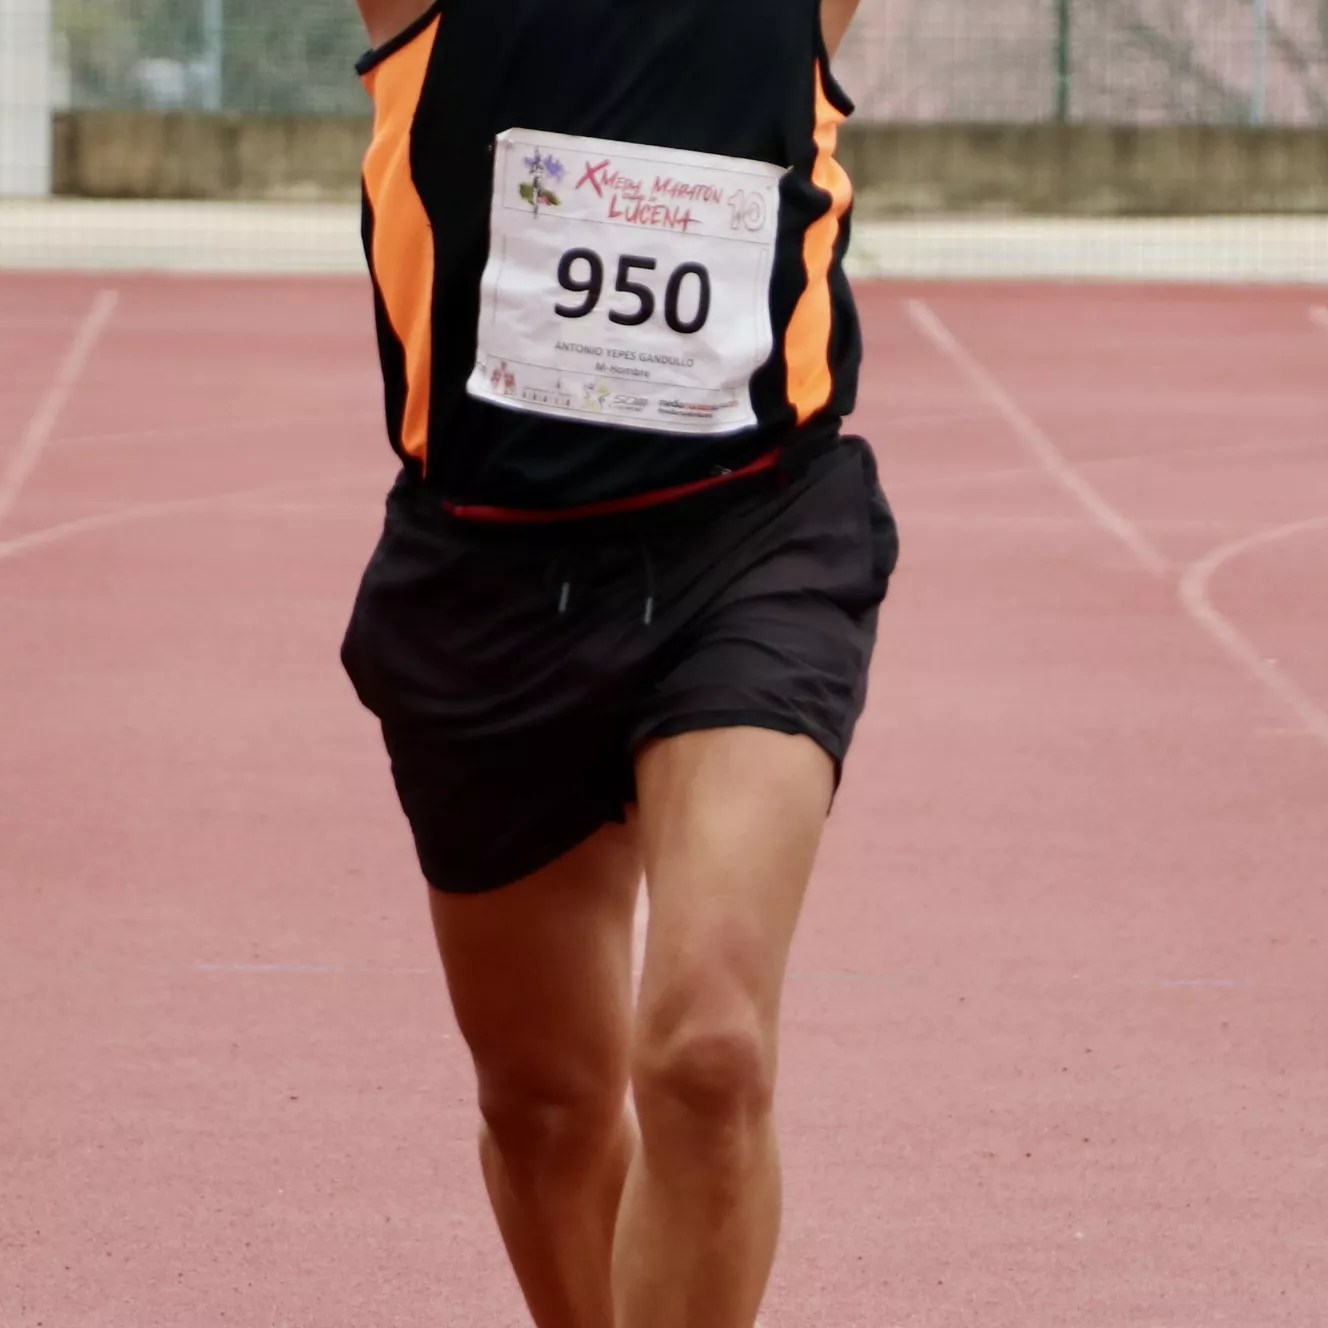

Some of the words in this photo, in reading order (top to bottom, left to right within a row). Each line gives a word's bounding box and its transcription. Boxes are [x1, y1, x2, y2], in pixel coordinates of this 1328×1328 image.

[608, 194, 703, 232] LUCENA
[553, 246, 712, 334] 950
[554, 340, 604, 357] ANTONIO
[605, 348, 637, 362] YEPES
[638, 352, 695, 369] GANDULLO
